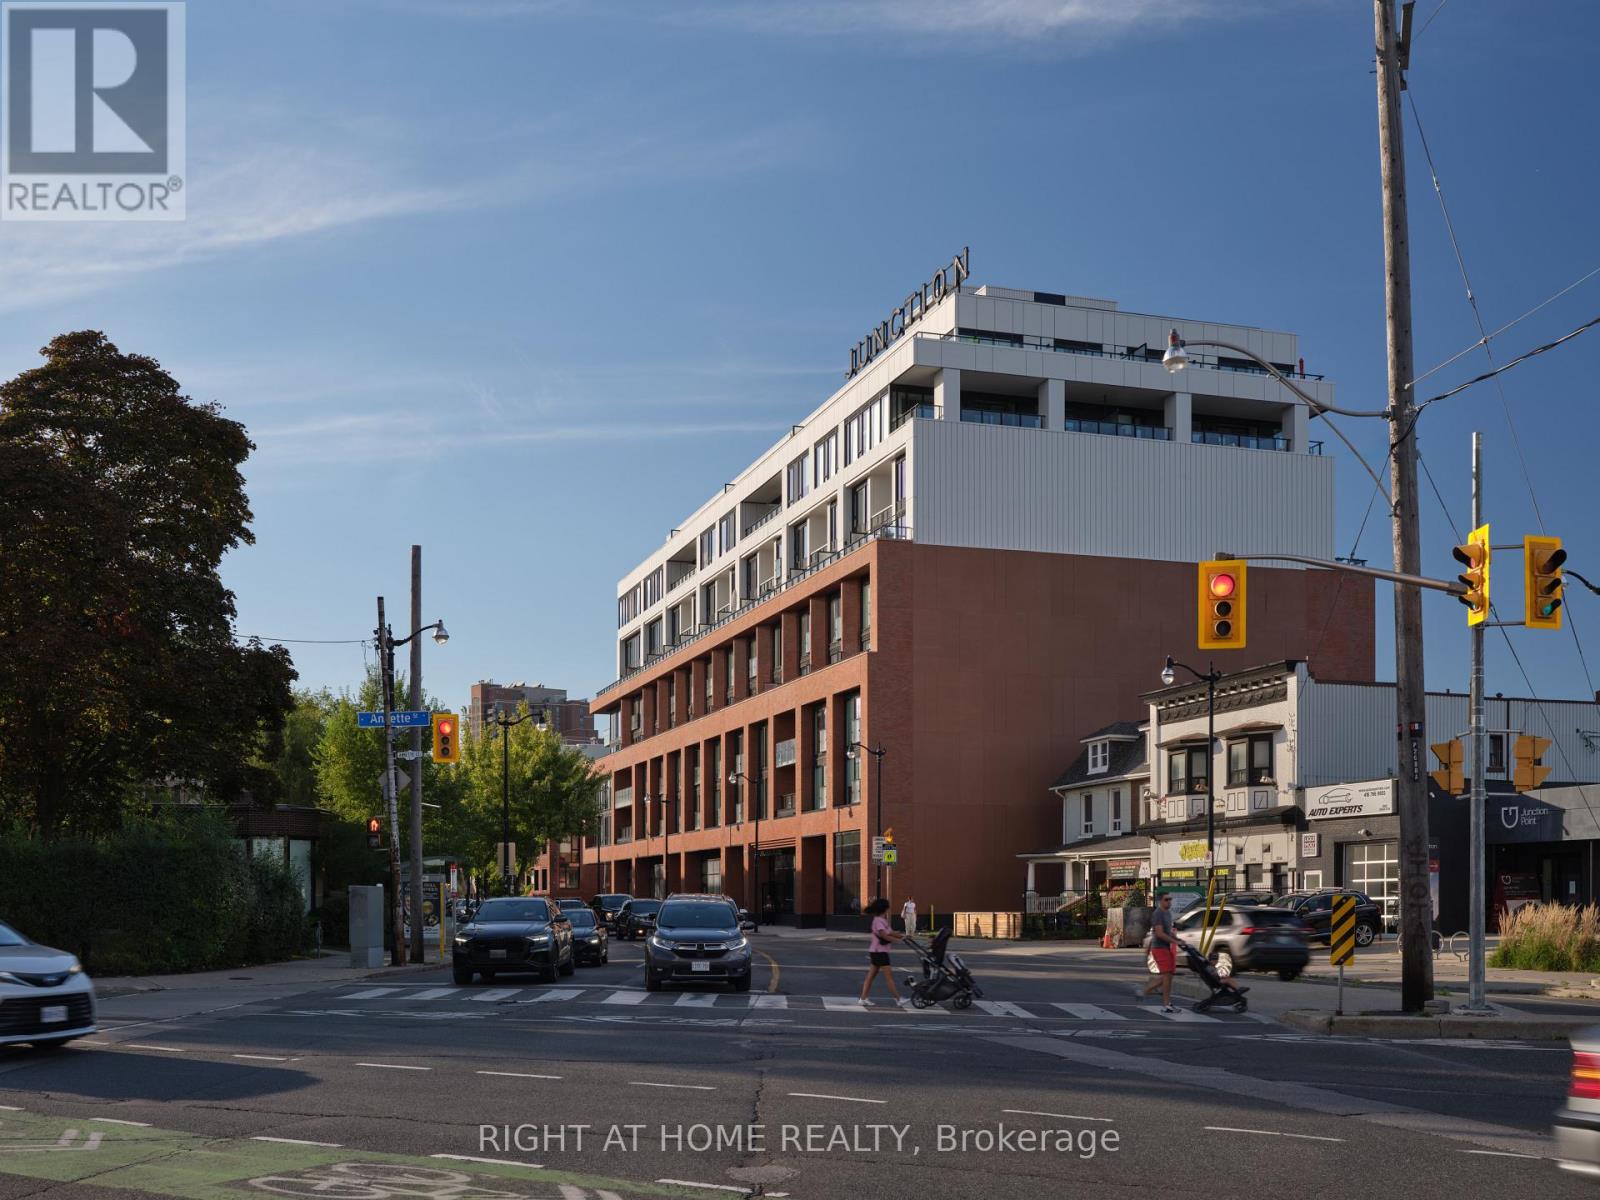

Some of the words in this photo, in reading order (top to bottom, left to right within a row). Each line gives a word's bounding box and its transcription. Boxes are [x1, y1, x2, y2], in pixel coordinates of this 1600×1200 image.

[845, 246, 970, 380] JUNCTION
[370, 713, 411, 724] Anette
[1308, 807, 1328, 817] AUTO
[1329, 804, 1363, 815] EXPERTS
[1520, 807, 1549, 817] Junction
[1520, 816, 1537, 825] Point
